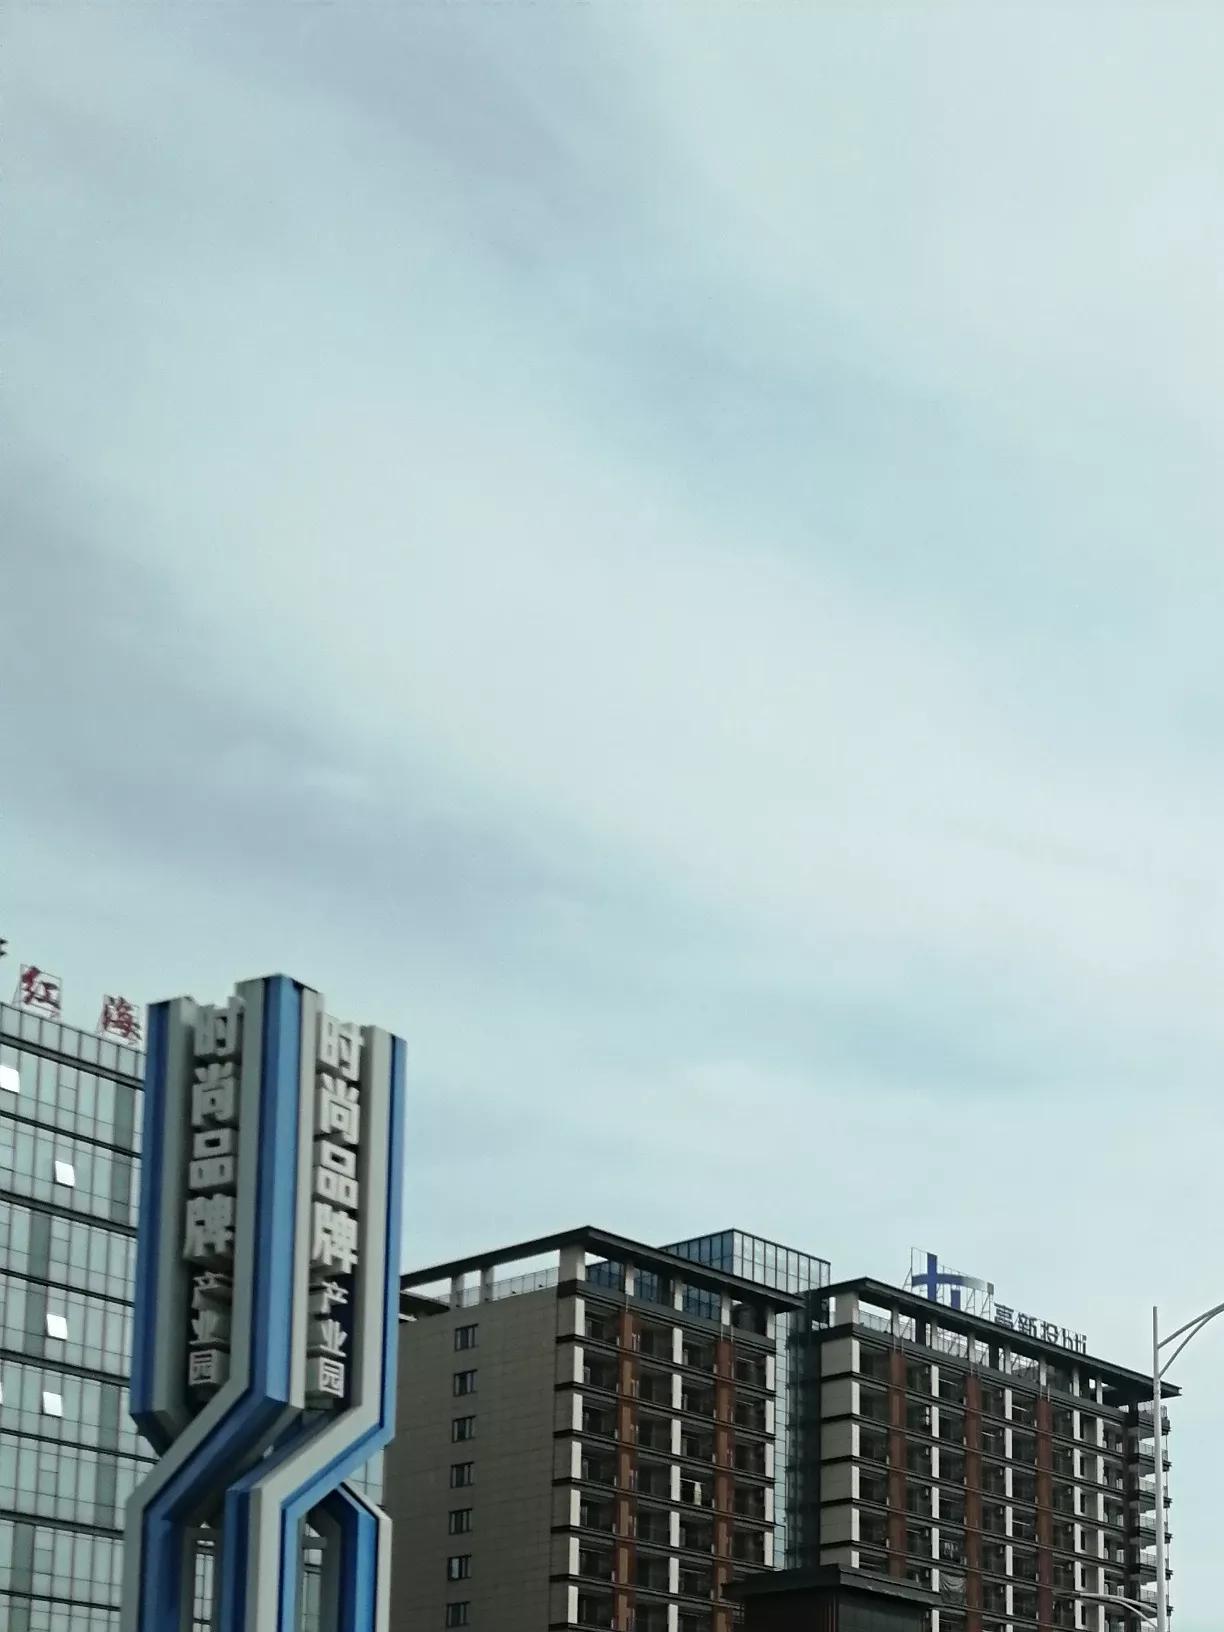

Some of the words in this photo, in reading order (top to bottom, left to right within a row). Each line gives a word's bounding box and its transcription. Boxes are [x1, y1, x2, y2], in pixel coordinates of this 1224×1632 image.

[314, 1011, 365, 1399] 时尚品牌产业园
